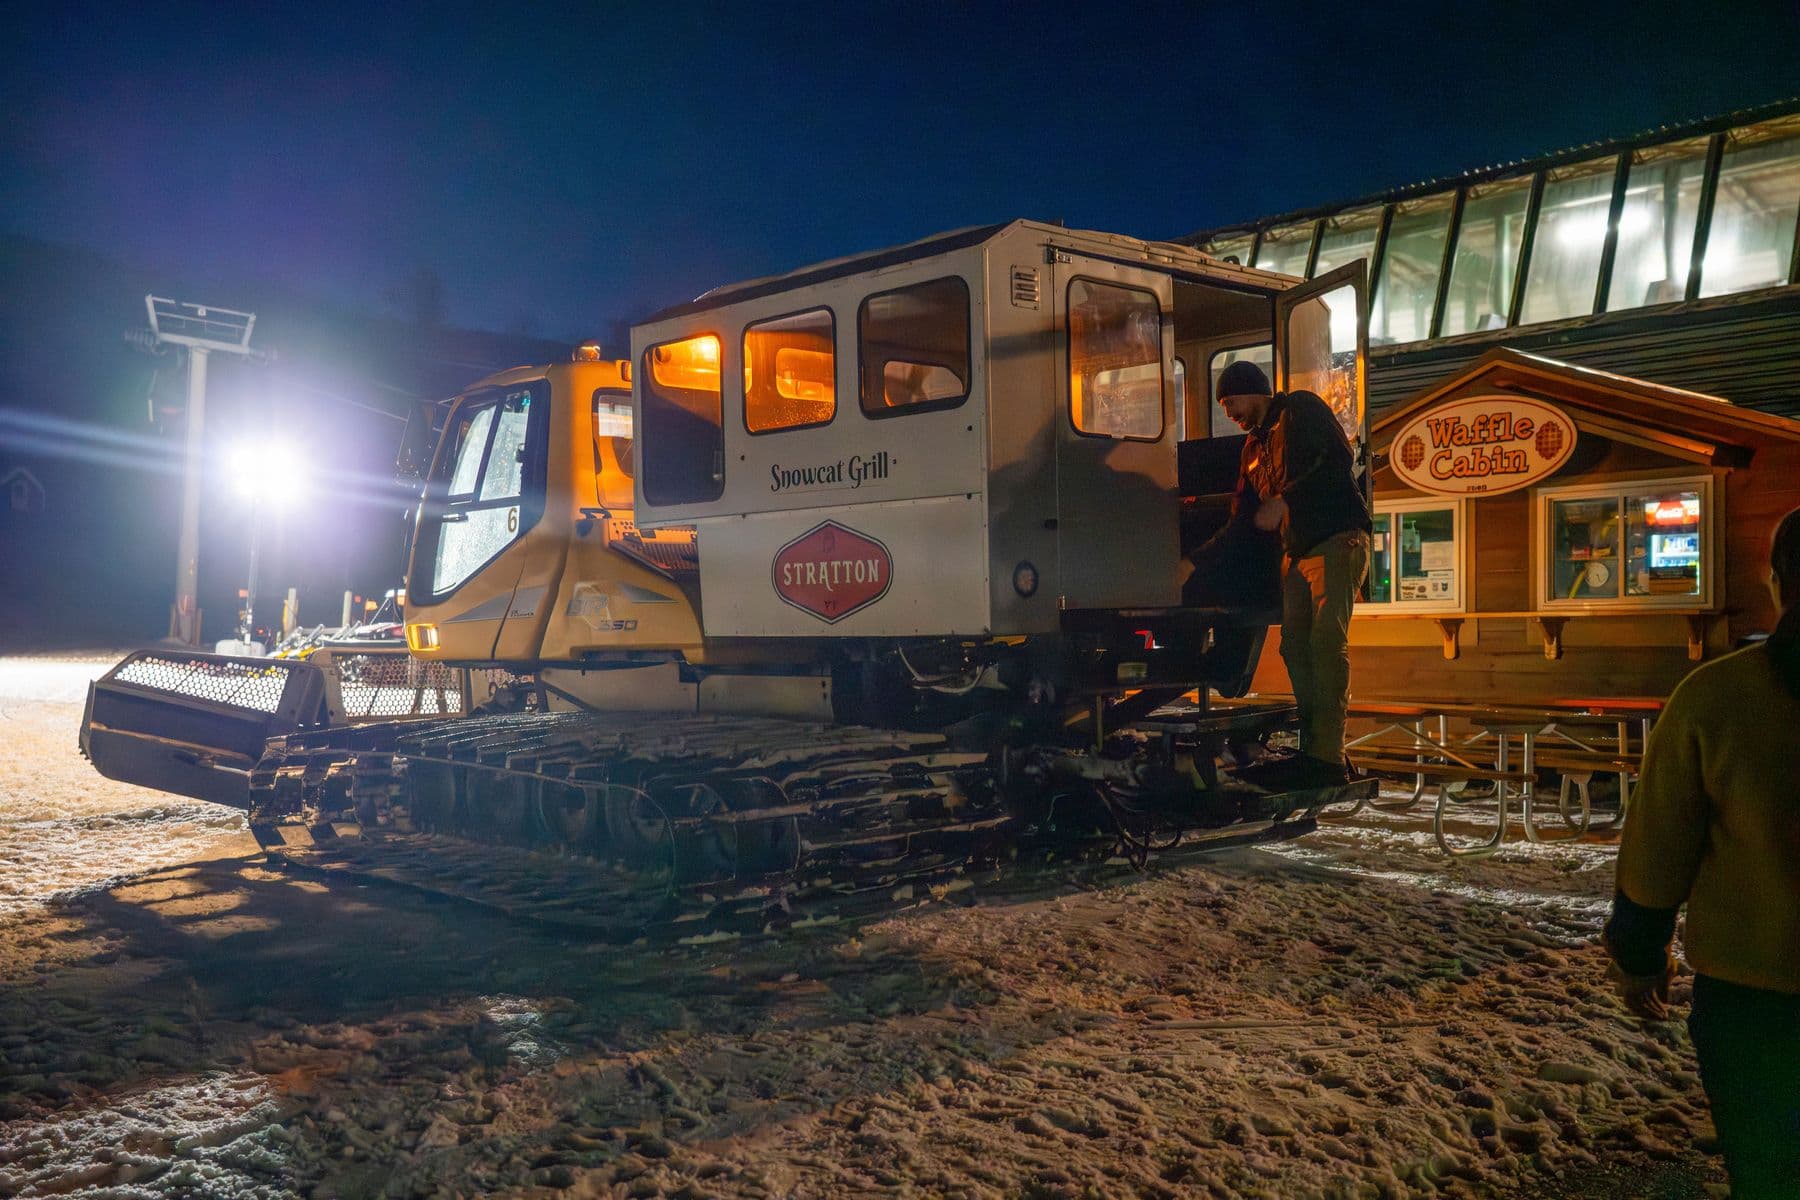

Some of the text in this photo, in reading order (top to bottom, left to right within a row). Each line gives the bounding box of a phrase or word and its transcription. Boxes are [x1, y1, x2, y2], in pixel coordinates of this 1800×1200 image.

[1427, 411, 1535, 449] Waffle
[771, 451, 888, 492] Snowcat Grill
[1429, 445, 1530, 480] Cabin
[507, 507, 518, 533] 6
[783, 559, 880, 592] STRATTON
